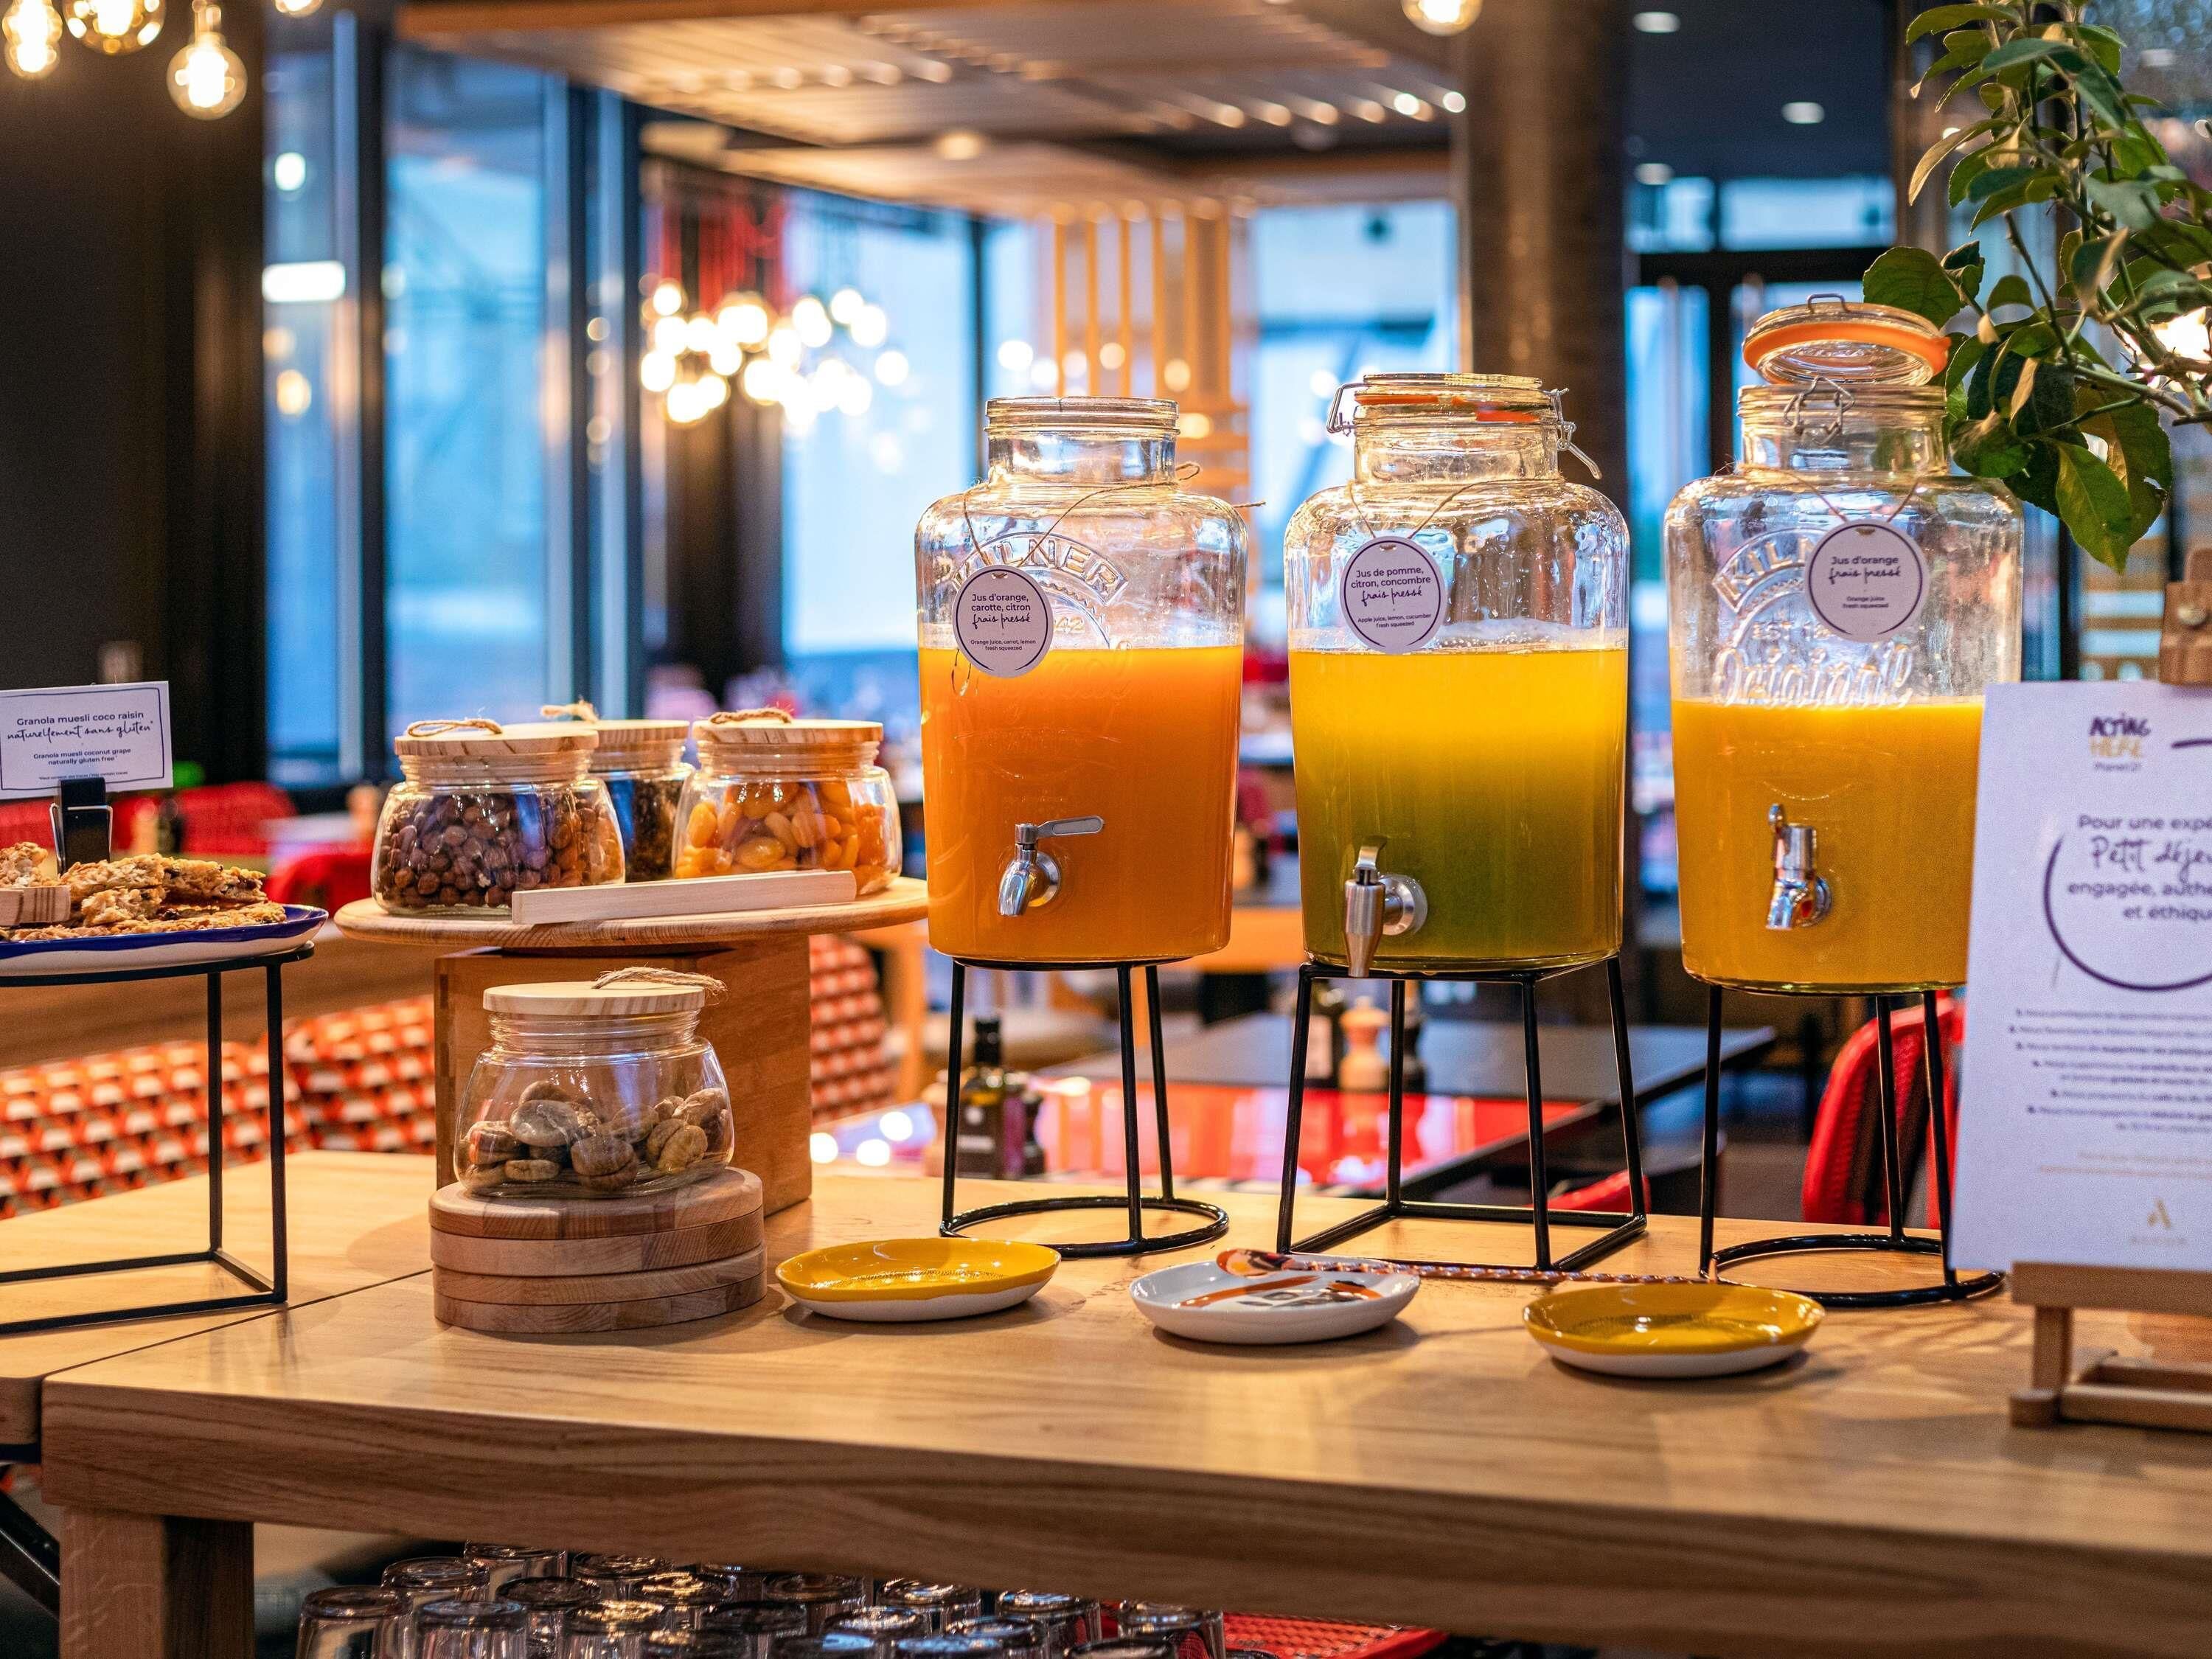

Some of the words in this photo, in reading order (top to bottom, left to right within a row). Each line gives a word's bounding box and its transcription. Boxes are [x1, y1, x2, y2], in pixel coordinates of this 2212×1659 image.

[1831, 556, 1850, 565] Jus
[1851, 555, 1899, 566] d'orange
[953, 539, 1120, 596] LNER
[1356, 570, 1371, 578] Jus
[1373, 568, 1384, 577] de
[1387, 567, 1424, 578] pomme,
[1351, 580, 1379, 588] citron,
[1380, 576, 1431, 587] concombre
[972, 594, 987, 602] Jus
[989, 593, 1029, 602] d'orange,
[1361, 590, 1389, 607] frais
[1391, 585, 1422, 605] pressé
[1006, 603, 1031, 611] citron
[972, 613, 998, 630] frais
[1001, 612, 1032, 629] pressé
[17, 716, 55, 726] Granola
[58, 713, 90, 723] muesli
[93, 713, 115, 722] coco
[118, 711, 144, 720] raisin
[7, 725, 82, 743] naturellement
[85, 726, 113, 734] sans
[33, 751, 59, 759] Granola
[84, 748, 111, 757] coconut
[112, 748, 131, 756] grape
[48, 757, 77, 766] naturally
[78, 757, 100, 765] gluten
[2079, 814, 2123, 830] Pour
[2129, 818, 2165, 830] une
[2124, 905, 2141, 918] et
